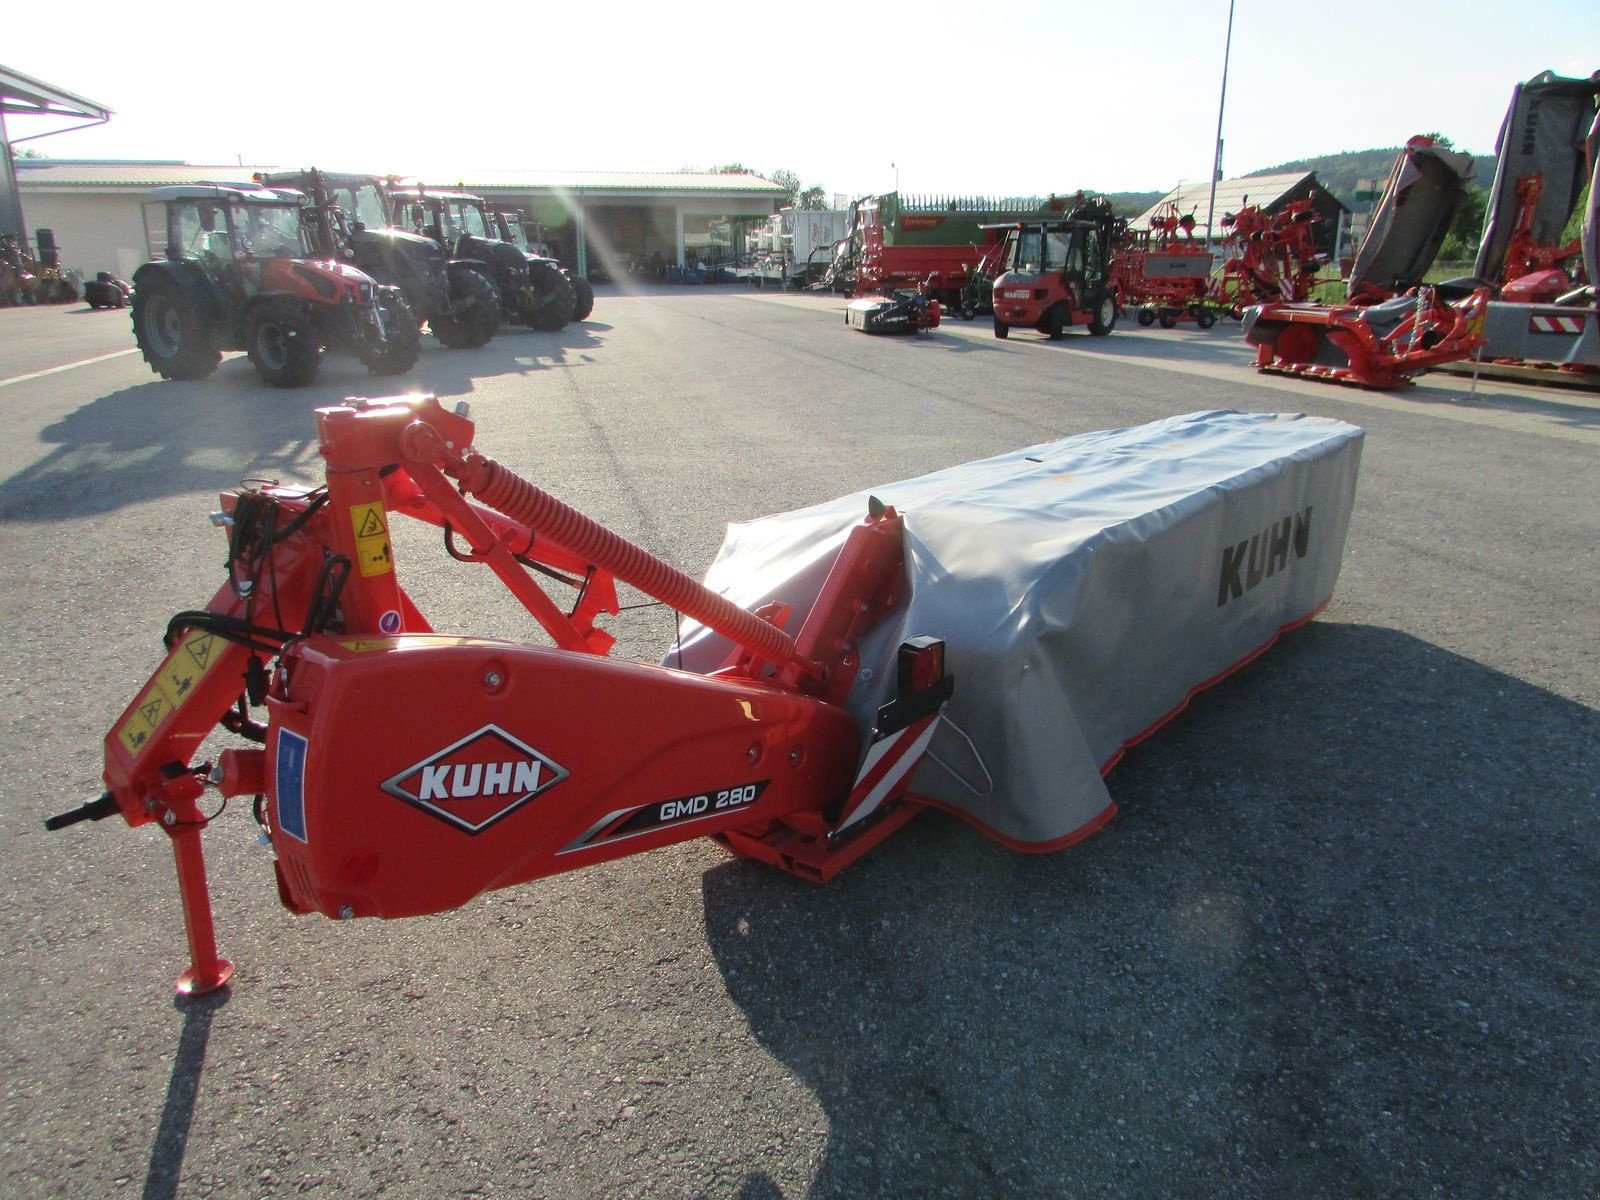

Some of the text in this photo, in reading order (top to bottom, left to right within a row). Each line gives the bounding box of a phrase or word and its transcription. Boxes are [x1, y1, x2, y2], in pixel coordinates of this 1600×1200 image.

[1521, 99, 1542, 155] KUHN
[1217, 505, 1313, 608] KUHN
[419, 760, 542, 800] KUHN
[660, 785, 756, 821] GMD 280
